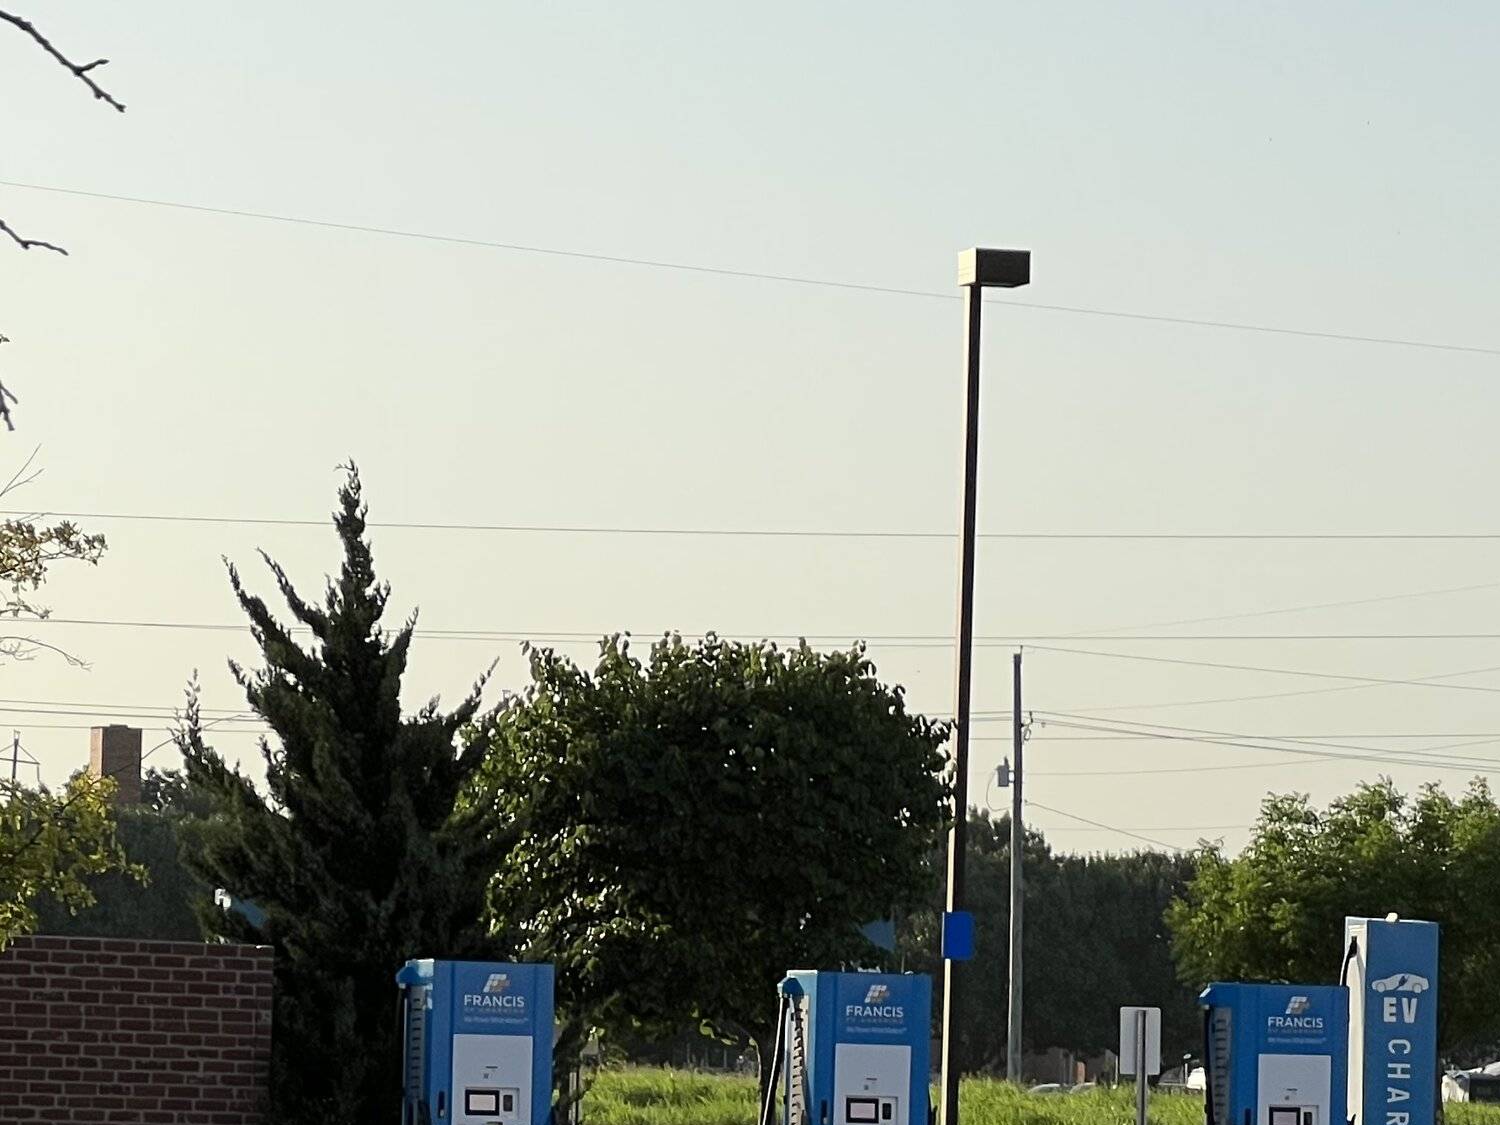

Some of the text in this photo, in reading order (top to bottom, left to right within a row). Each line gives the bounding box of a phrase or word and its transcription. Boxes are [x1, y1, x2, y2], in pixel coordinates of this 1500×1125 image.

[464, 994, 525, 1008] FRANCIS
[846, 1005, 904, 1018] FRANCIS
[1383, 997, 1418, 1024] EV
[1268, 1016, 1323, 1029] FRANCIS
